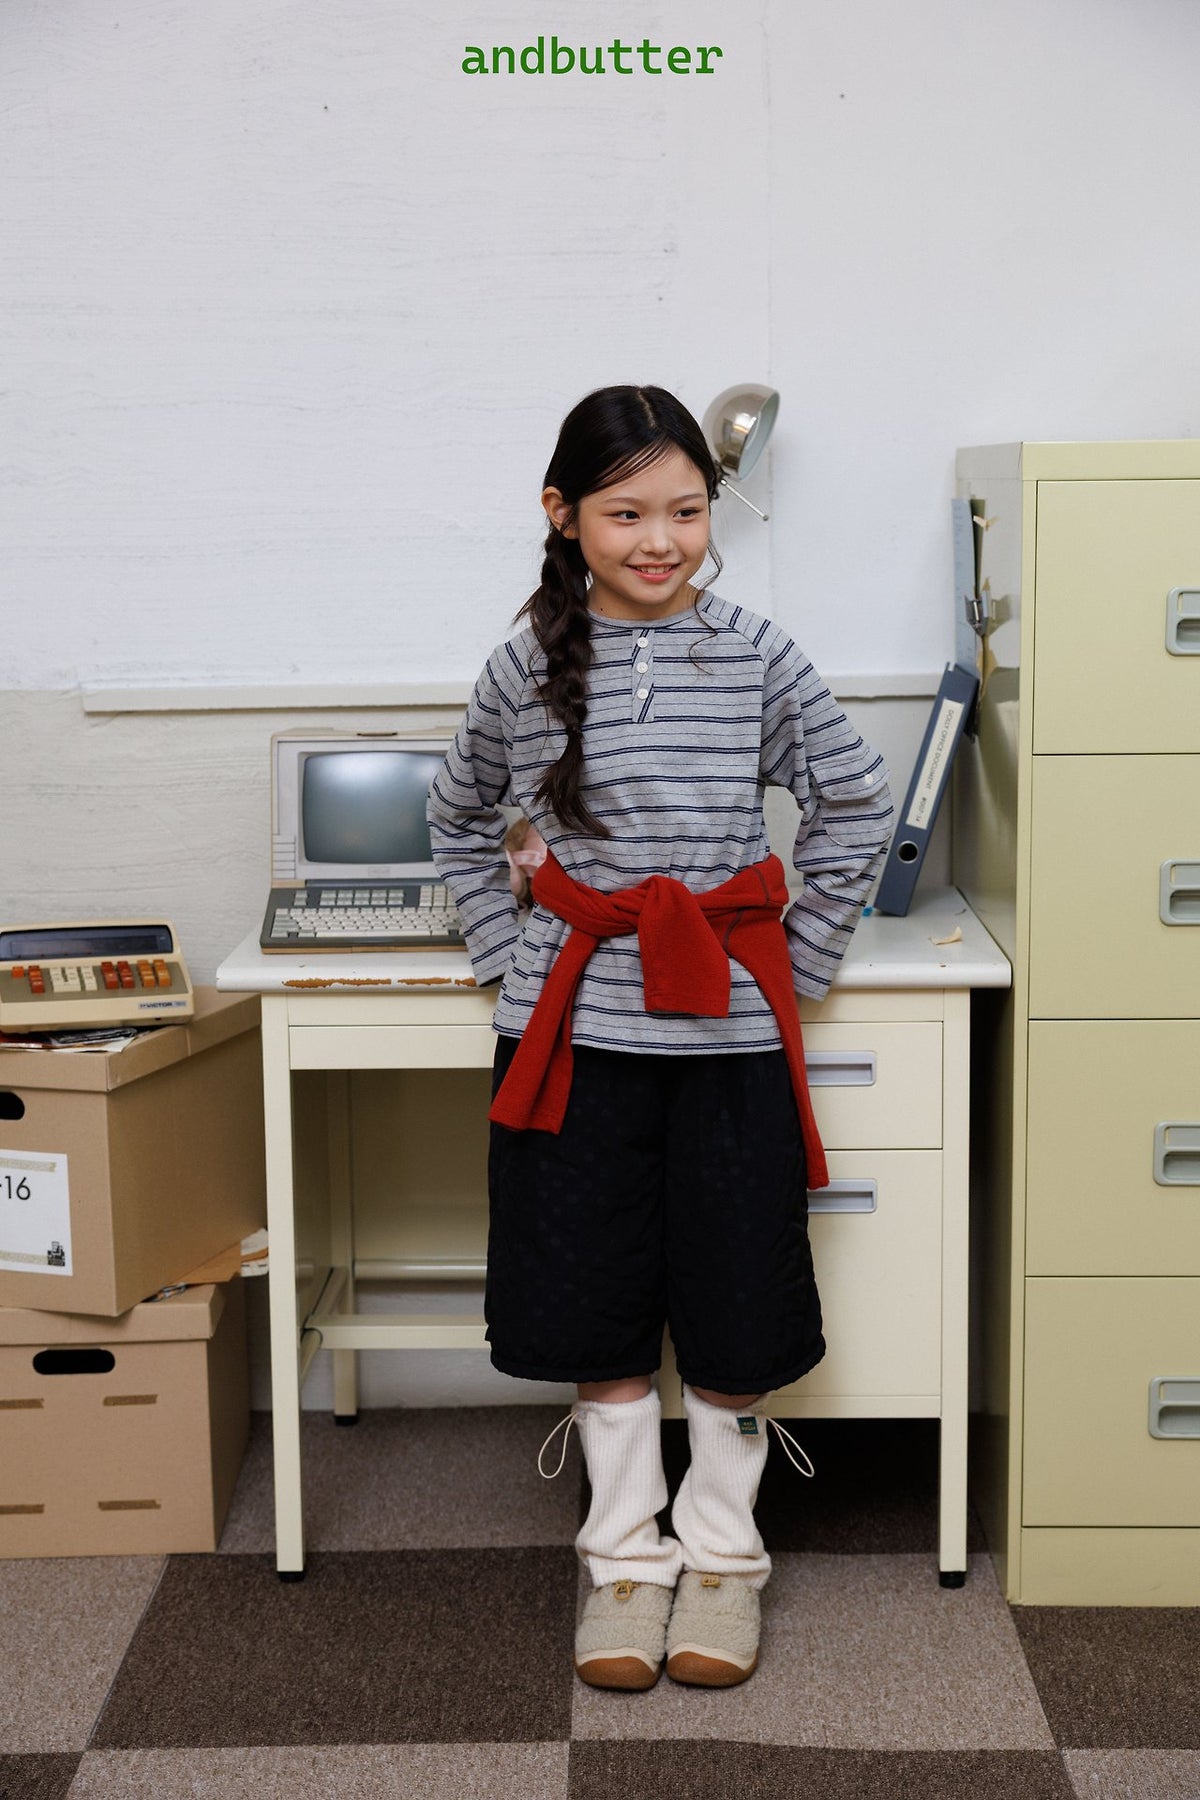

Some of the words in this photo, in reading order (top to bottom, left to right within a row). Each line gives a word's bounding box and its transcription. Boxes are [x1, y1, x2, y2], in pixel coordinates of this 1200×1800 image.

[944, 709, 954, 730] DOLLY
[937, 730, 948, 752] OFFICE
[925, 752, 941, 790] DOCUMENT
